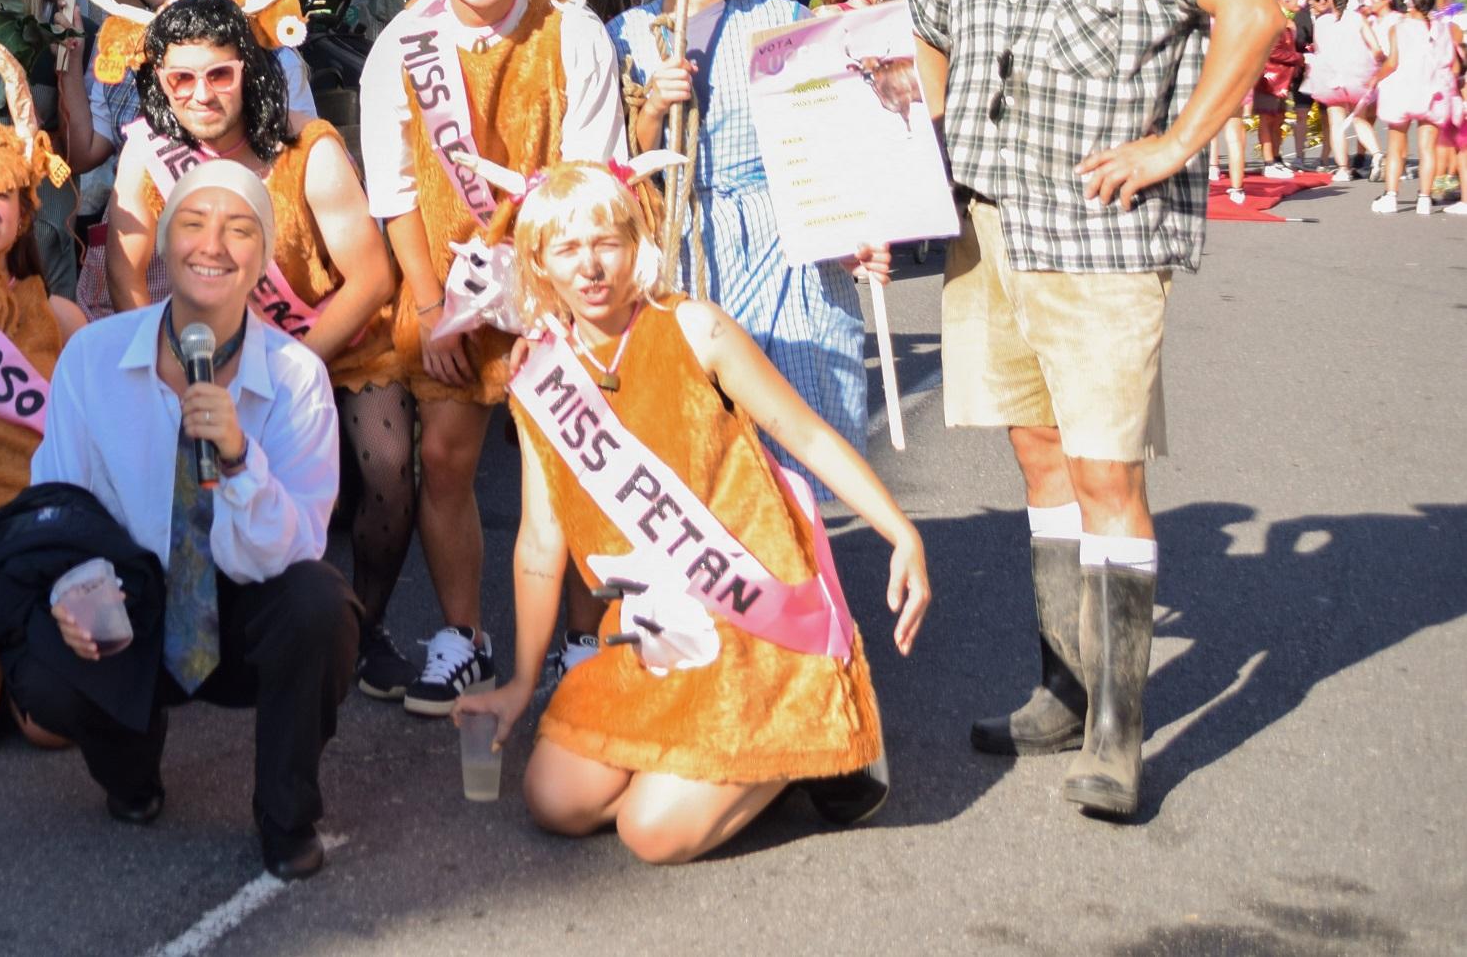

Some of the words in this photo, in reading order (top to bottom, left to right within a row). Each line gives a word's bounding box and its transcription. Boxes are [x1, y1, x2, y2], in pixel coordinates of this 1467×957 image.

[399, 30, 451, 110] MISS
[758, 38, 793, 55] VOTA
[534, 364, 622, 473] MISS
